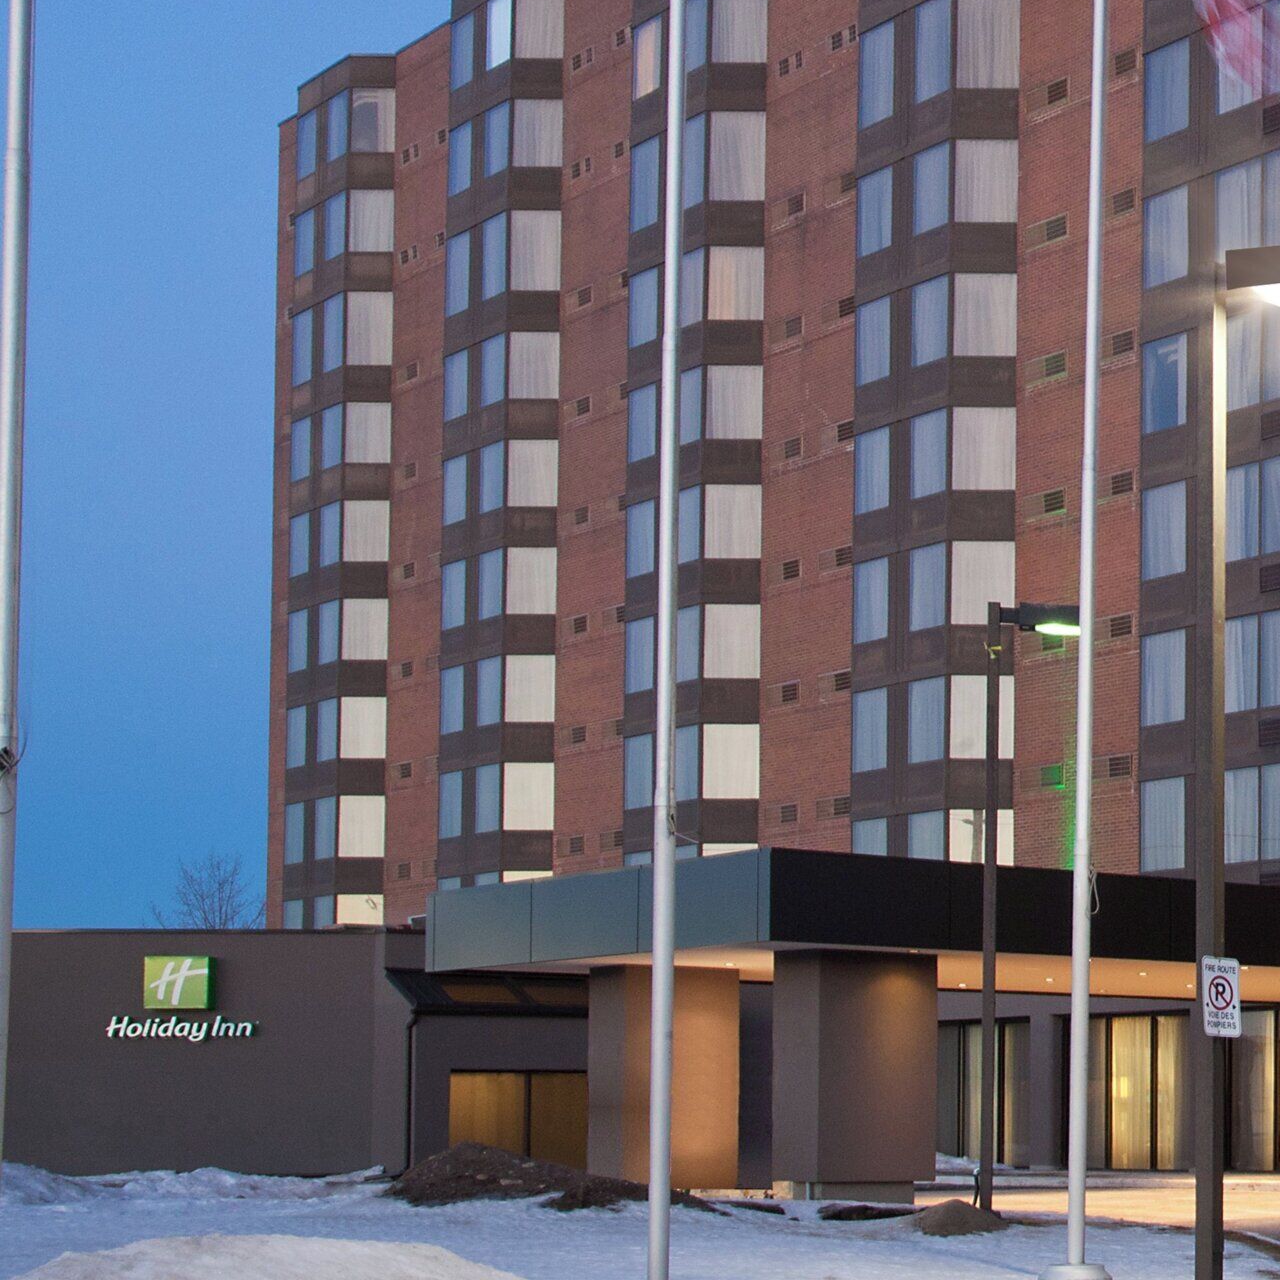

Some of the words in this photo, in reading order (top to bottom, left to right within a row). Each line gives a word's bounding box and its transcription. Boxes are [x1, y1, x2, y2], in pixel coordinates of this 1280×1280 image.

[1205, 964, 1216, 972] FIRE
[1217, 965, 1237, 974] ROUTE
[1208, 1011, 1219, 1019] VOIE
[1221, 1012, 1235, 1020] DES
[105, 1016, 208, 1042] Holiday
[211, 1015, 253, 1036] Inn
[1207, 1020, 1237, 1029] POMPIERS
